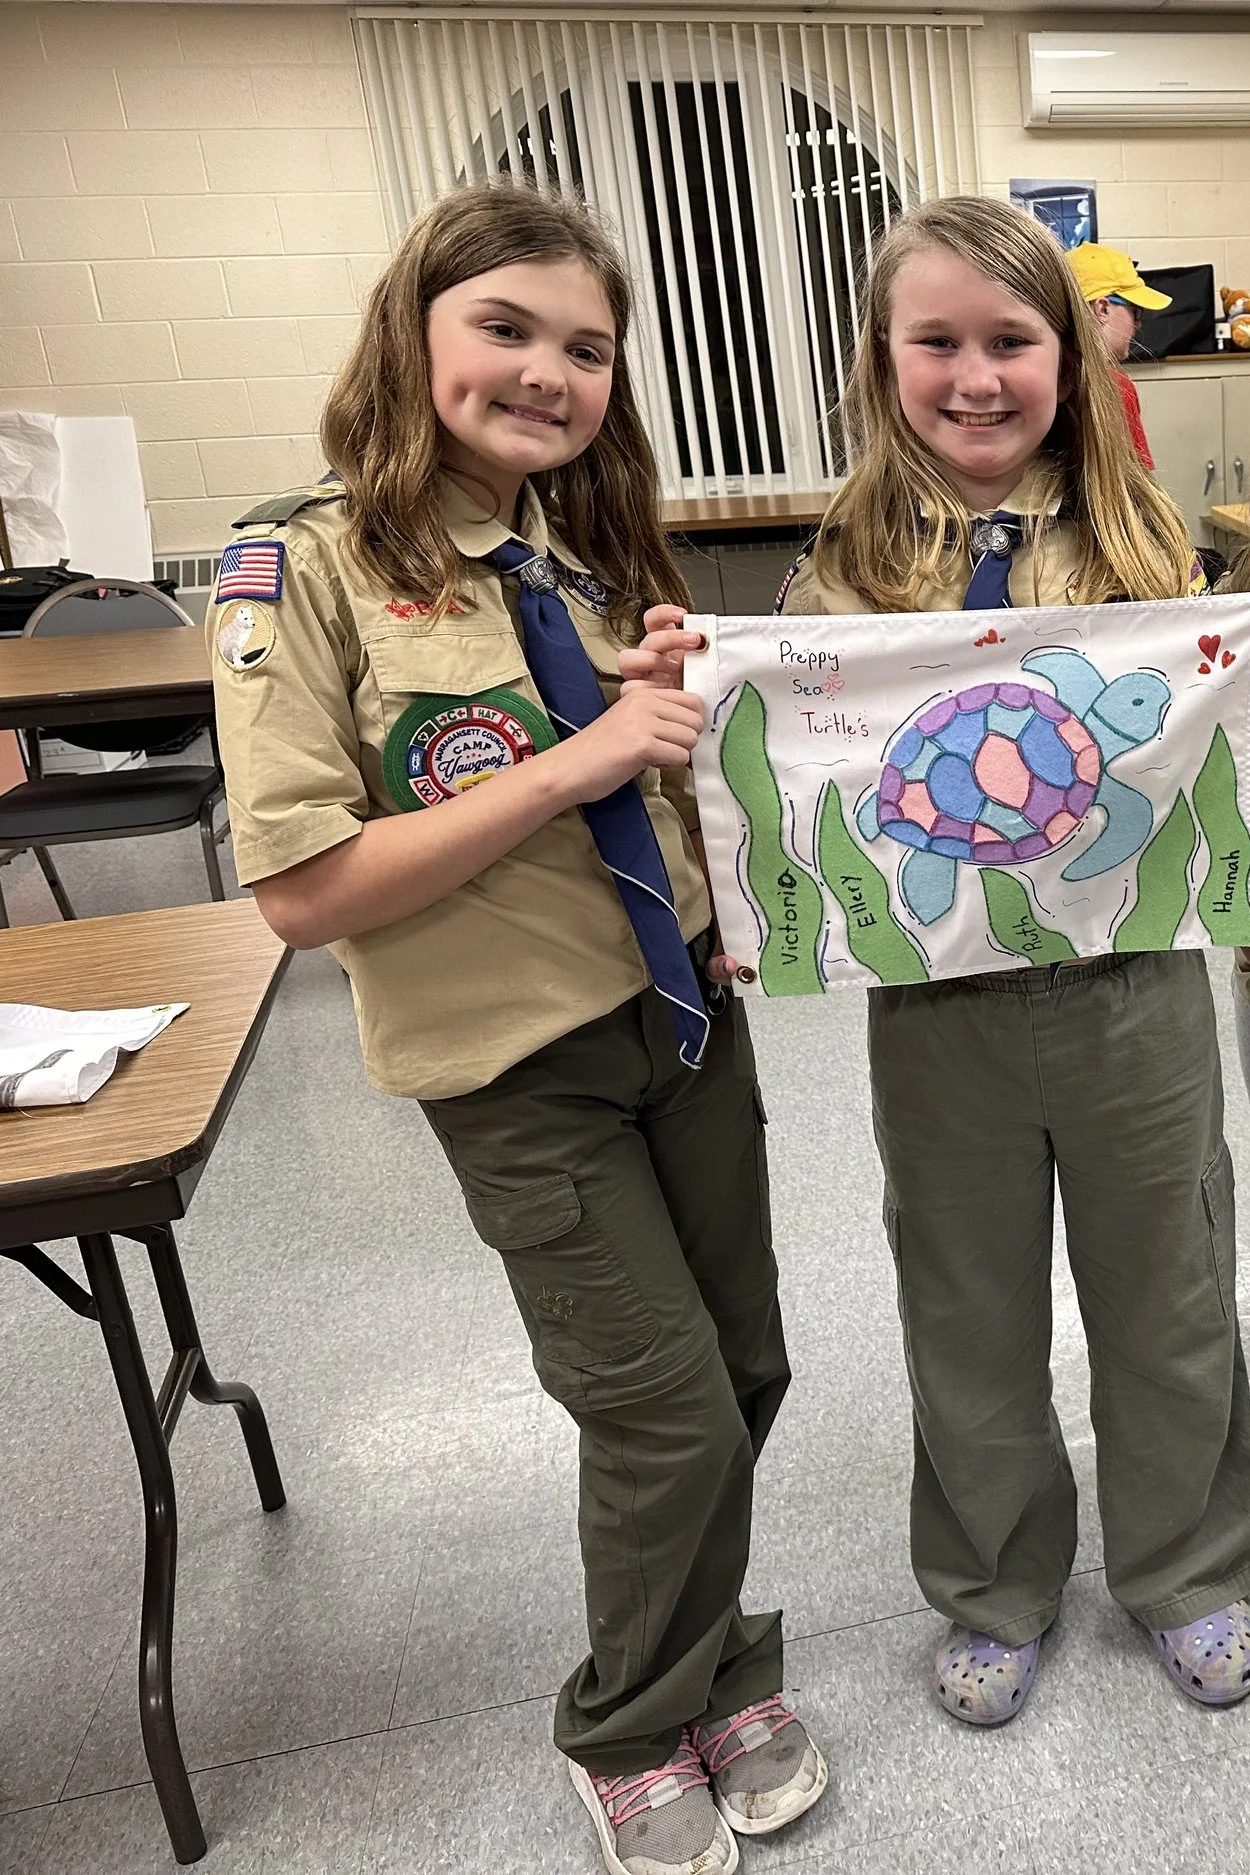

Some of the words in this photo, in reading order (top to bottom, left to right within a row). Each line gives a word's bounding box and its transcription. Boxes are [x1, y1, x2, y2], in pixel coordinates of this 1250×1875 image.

[779, 640, 840, 672] Preppy
[792, 678, 824, 696] Sea
[477, 708, 498, 721] HAT
[799, 712, 869, 737] Turtle's
[434, 728, 481, 762] NARRAGANSETT
[481, 730, 507, 753] COUNCIL
[452, 740, 492, 755] CAMP
[437, 753, 511, 784] Yawgoog
[1212, 849, 1241, 913] Hannah
[777, 867, 799, 966] Victoria
[840, 875, 878, 928] Ellery
[1012, 915, 1044, 952] Ruth
